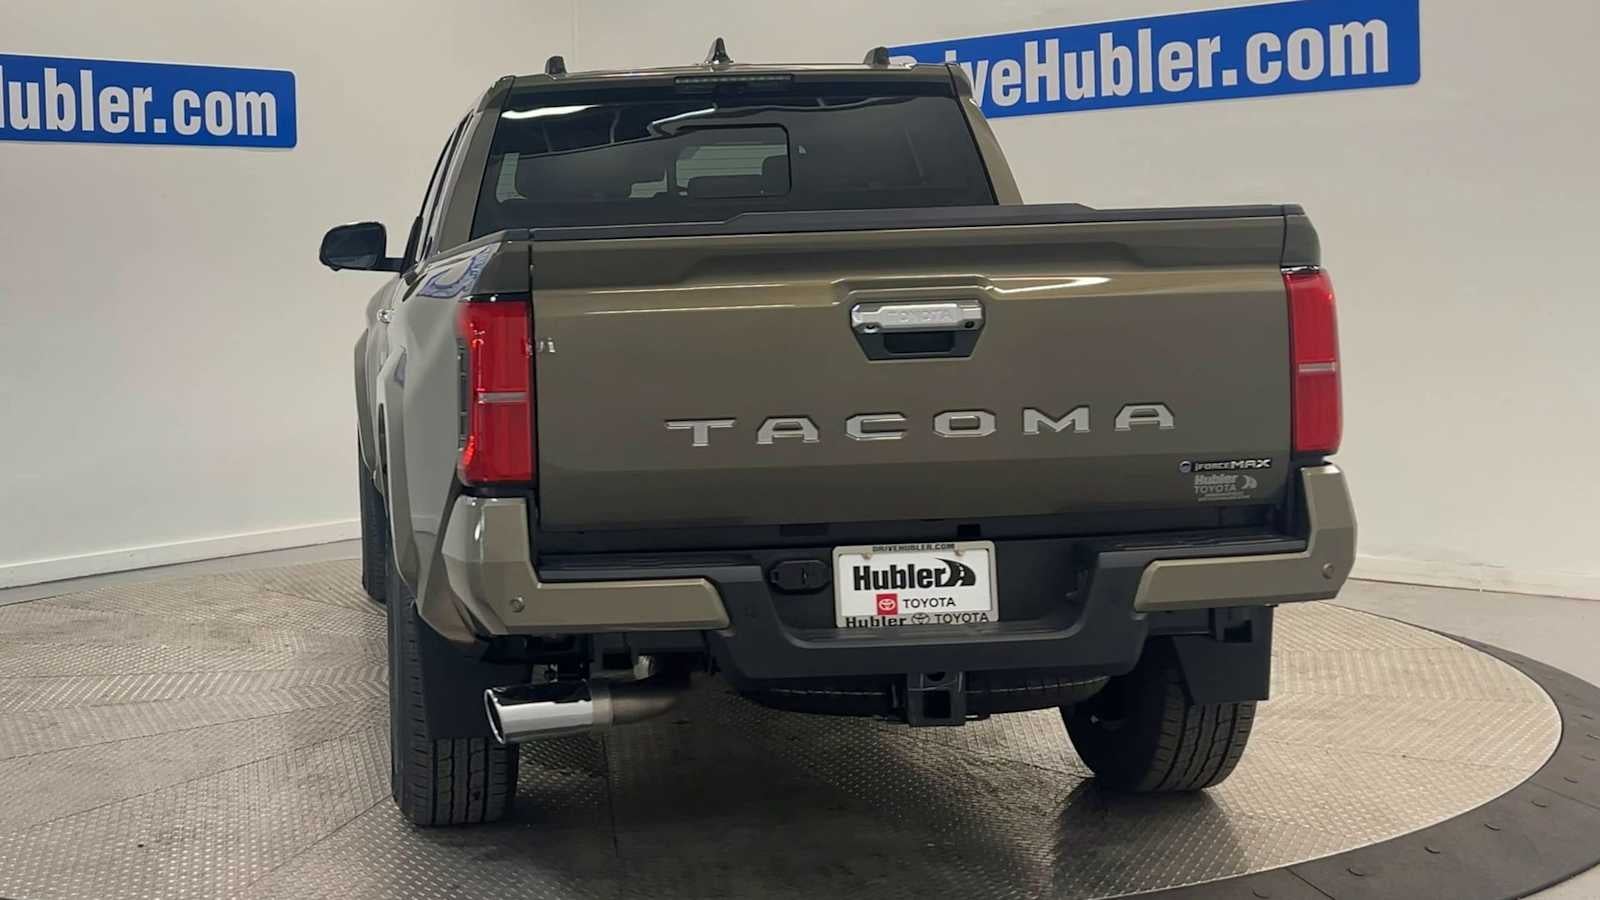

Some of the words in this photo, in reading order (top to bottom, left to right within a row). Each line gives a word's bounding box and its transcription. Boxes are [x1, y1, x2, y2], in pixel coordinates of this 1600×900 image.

[888, 18, 1388, 109] veHubler.com
[0, 65, 278, 137] ubler.com
[664, 402, 1176, 447] TACOMA
[1193, 484, 1237, 494] TOYOTA
[872, 543, 956, 553] DRIVEHUBLER.COM
[853, 564, 947, 591] Hubler
[903, 597, 957, 609] TOYOTA
[845, 614, 908, 628] Hubler
[934, 612, 990, 625] TOYOTA
